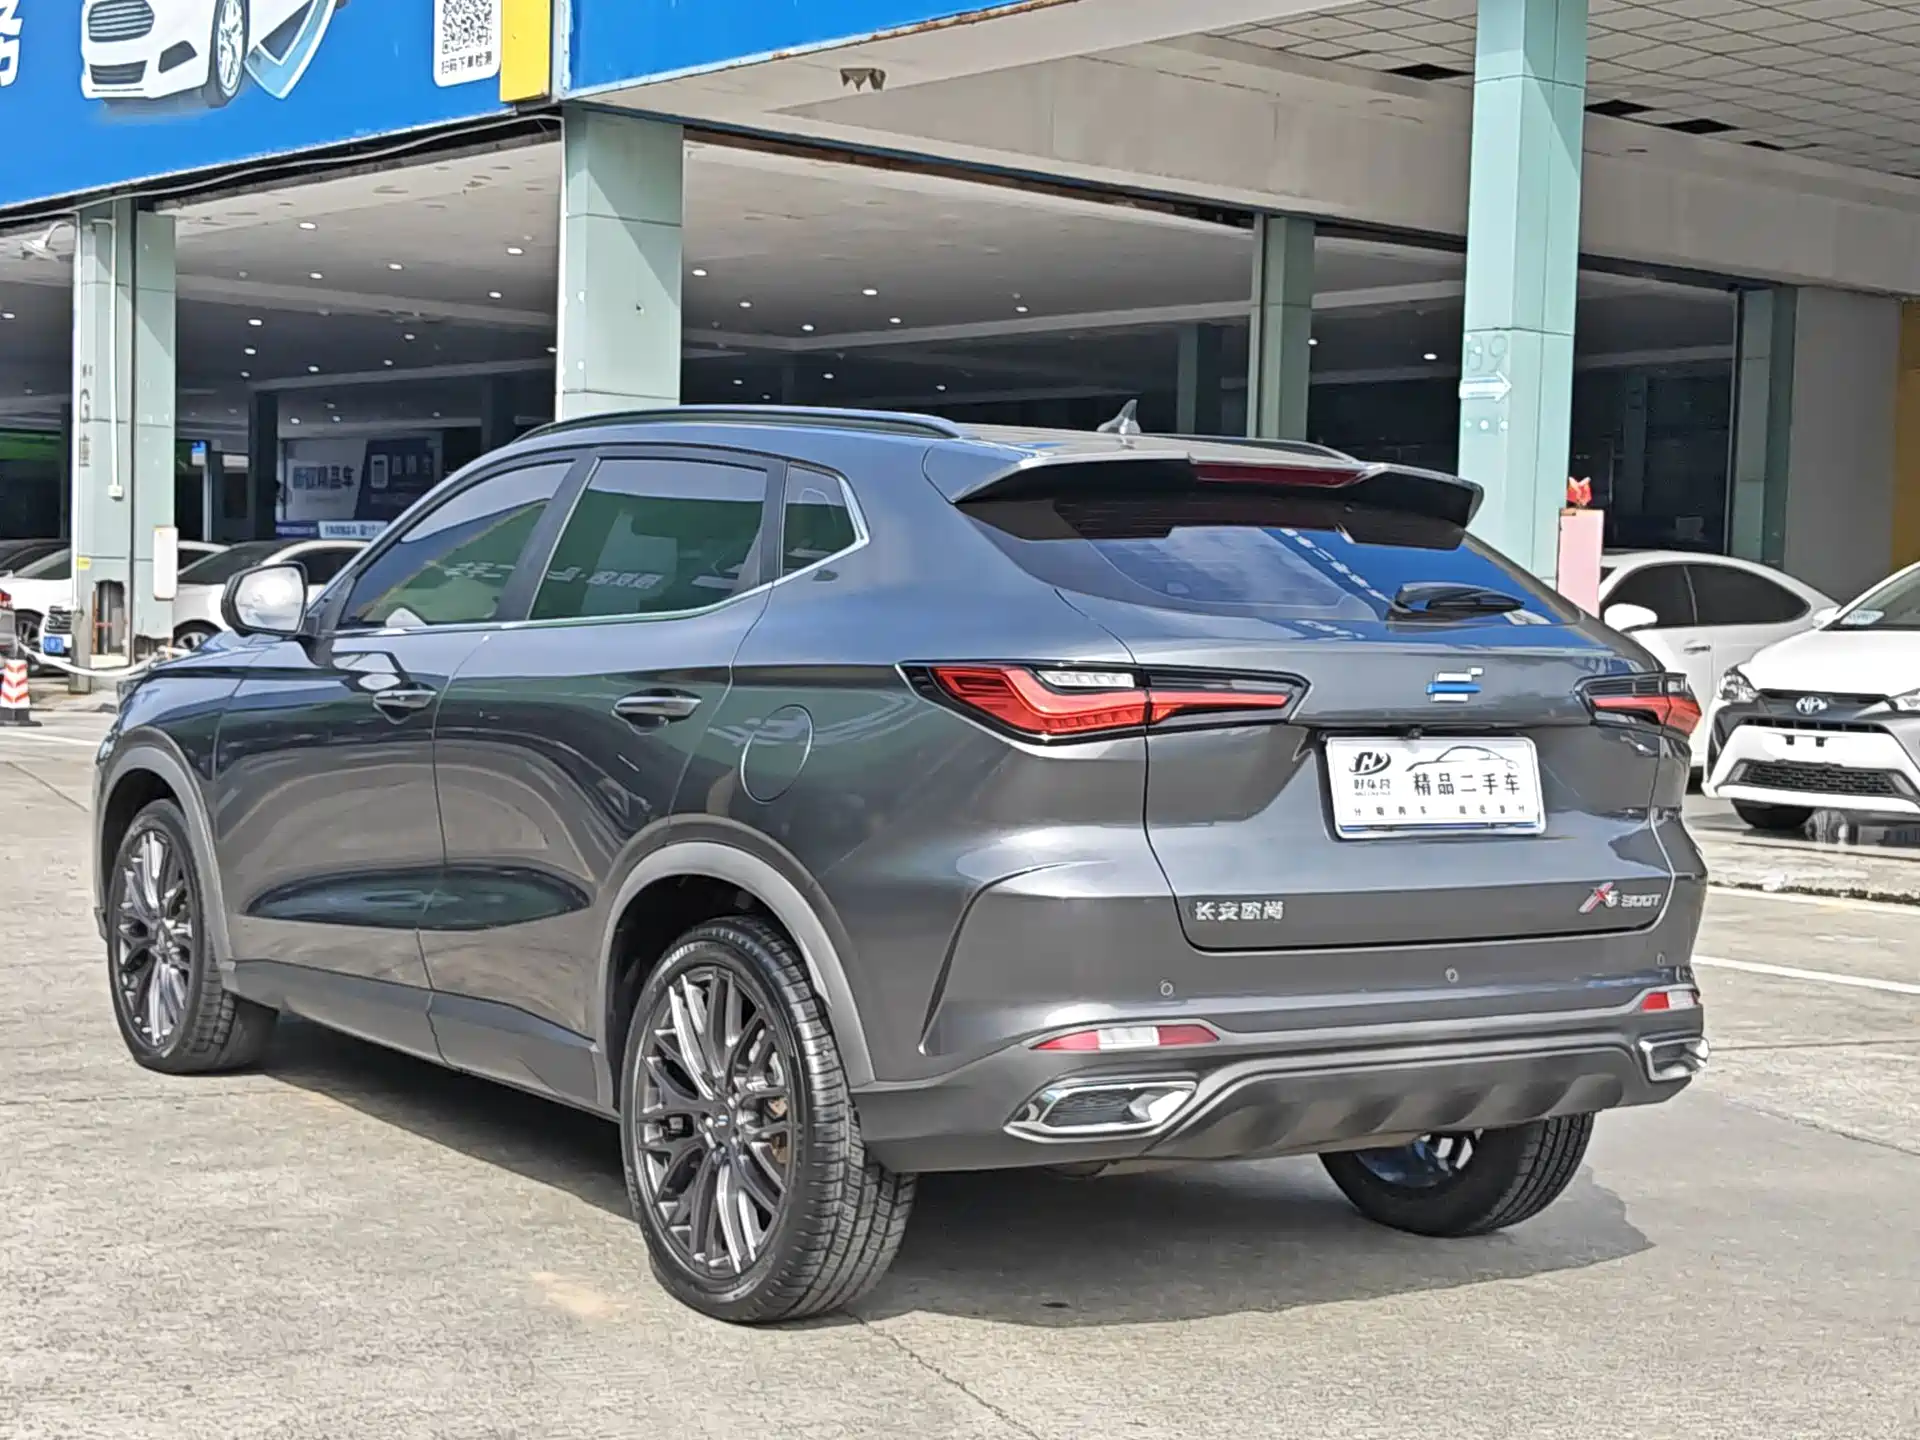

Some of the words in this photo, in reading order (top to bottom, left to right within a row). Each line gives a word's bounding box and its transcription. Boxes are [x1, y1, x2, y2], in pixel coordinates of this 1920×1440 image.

[1413, 772, 1520, 796] 精品二手车
[1195, 901, 1284, 921] 长安欧尚
